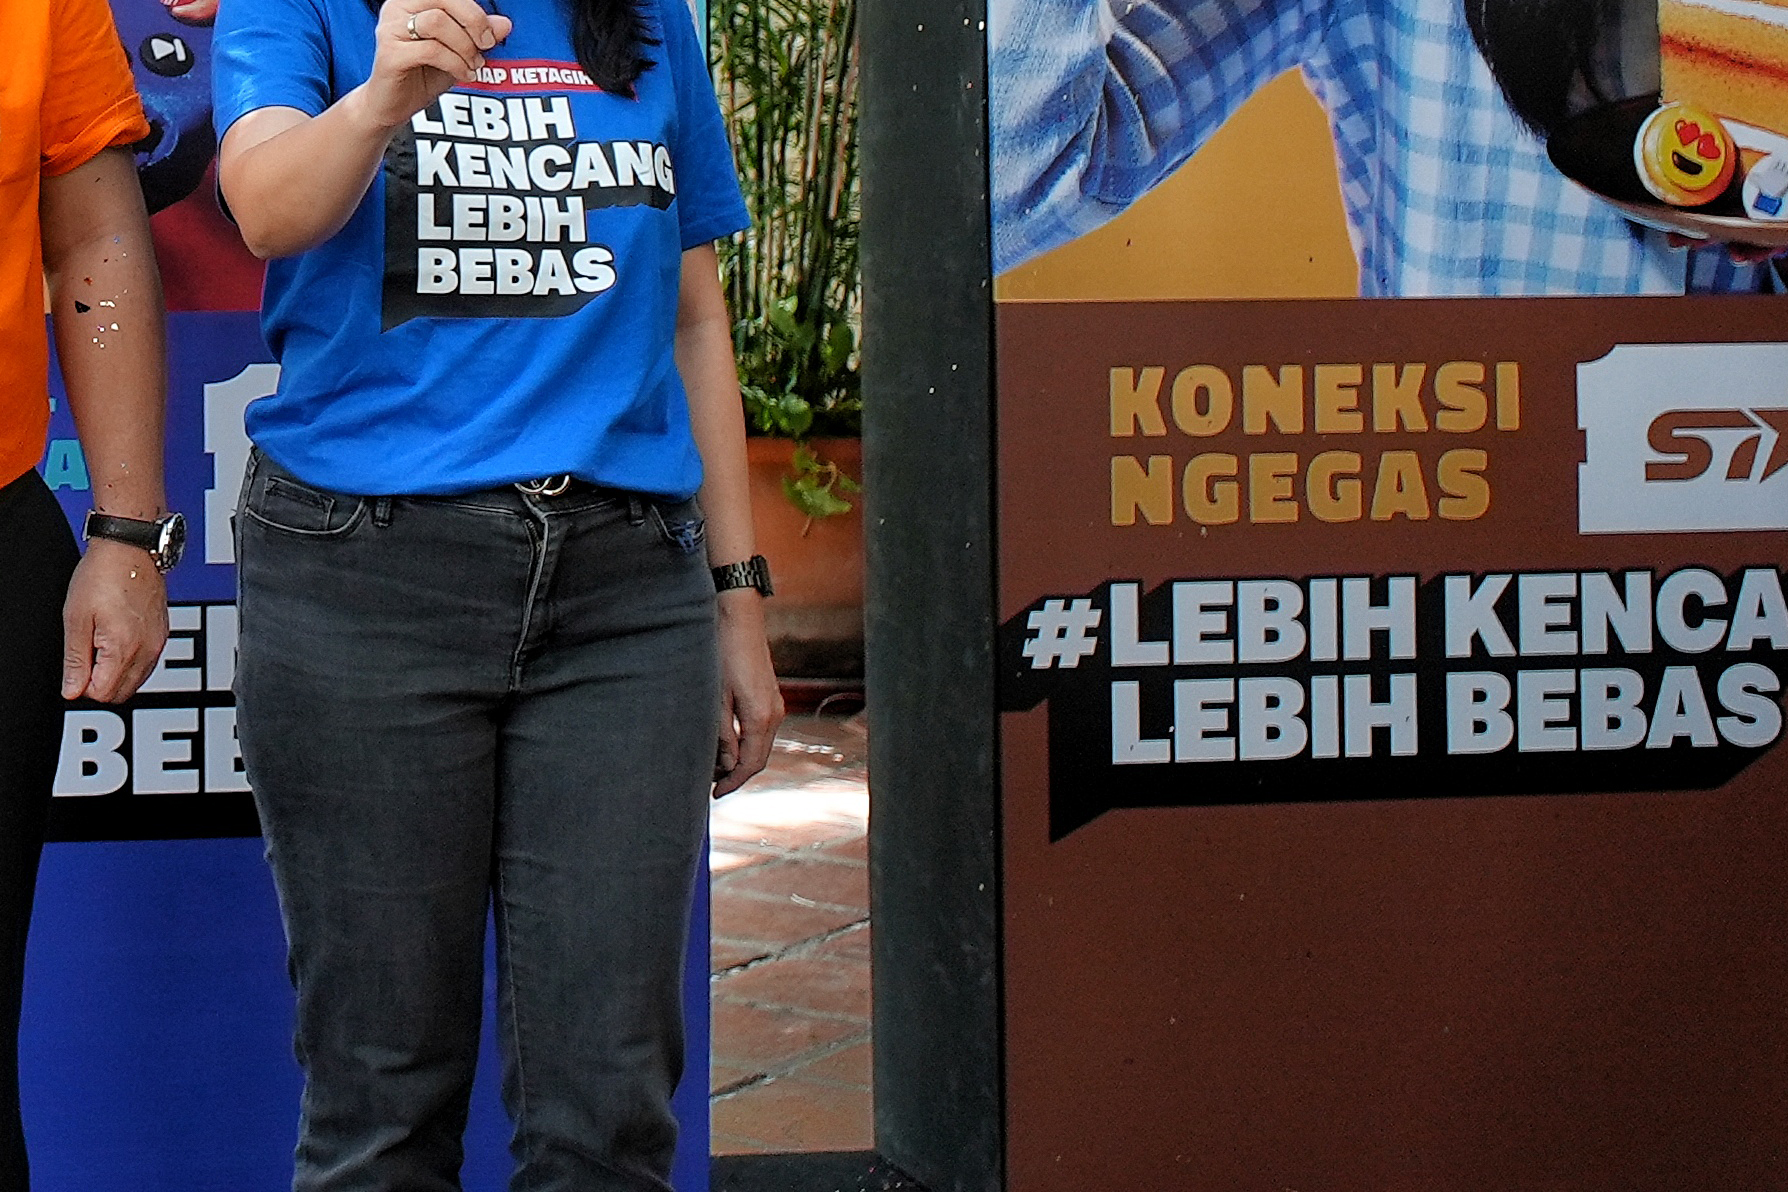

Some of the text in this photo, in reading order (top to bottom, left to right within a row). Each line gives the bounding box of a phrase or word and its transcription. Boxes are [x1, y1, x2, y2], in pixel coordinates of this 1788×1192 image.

[415, 138, 677, 195] KENCANG
[416, 192, 587, 243] LEBIH
[416, 245, 618, 297] BEBAS
[1109, 361, 1521, 438] KONEKSI
[1110, 449, 1492, 527] NGEGAS
[1021, 576, 1417, 670] #LEBIH
[1110, 662, 1783, 765] LEBIH BEBAS
